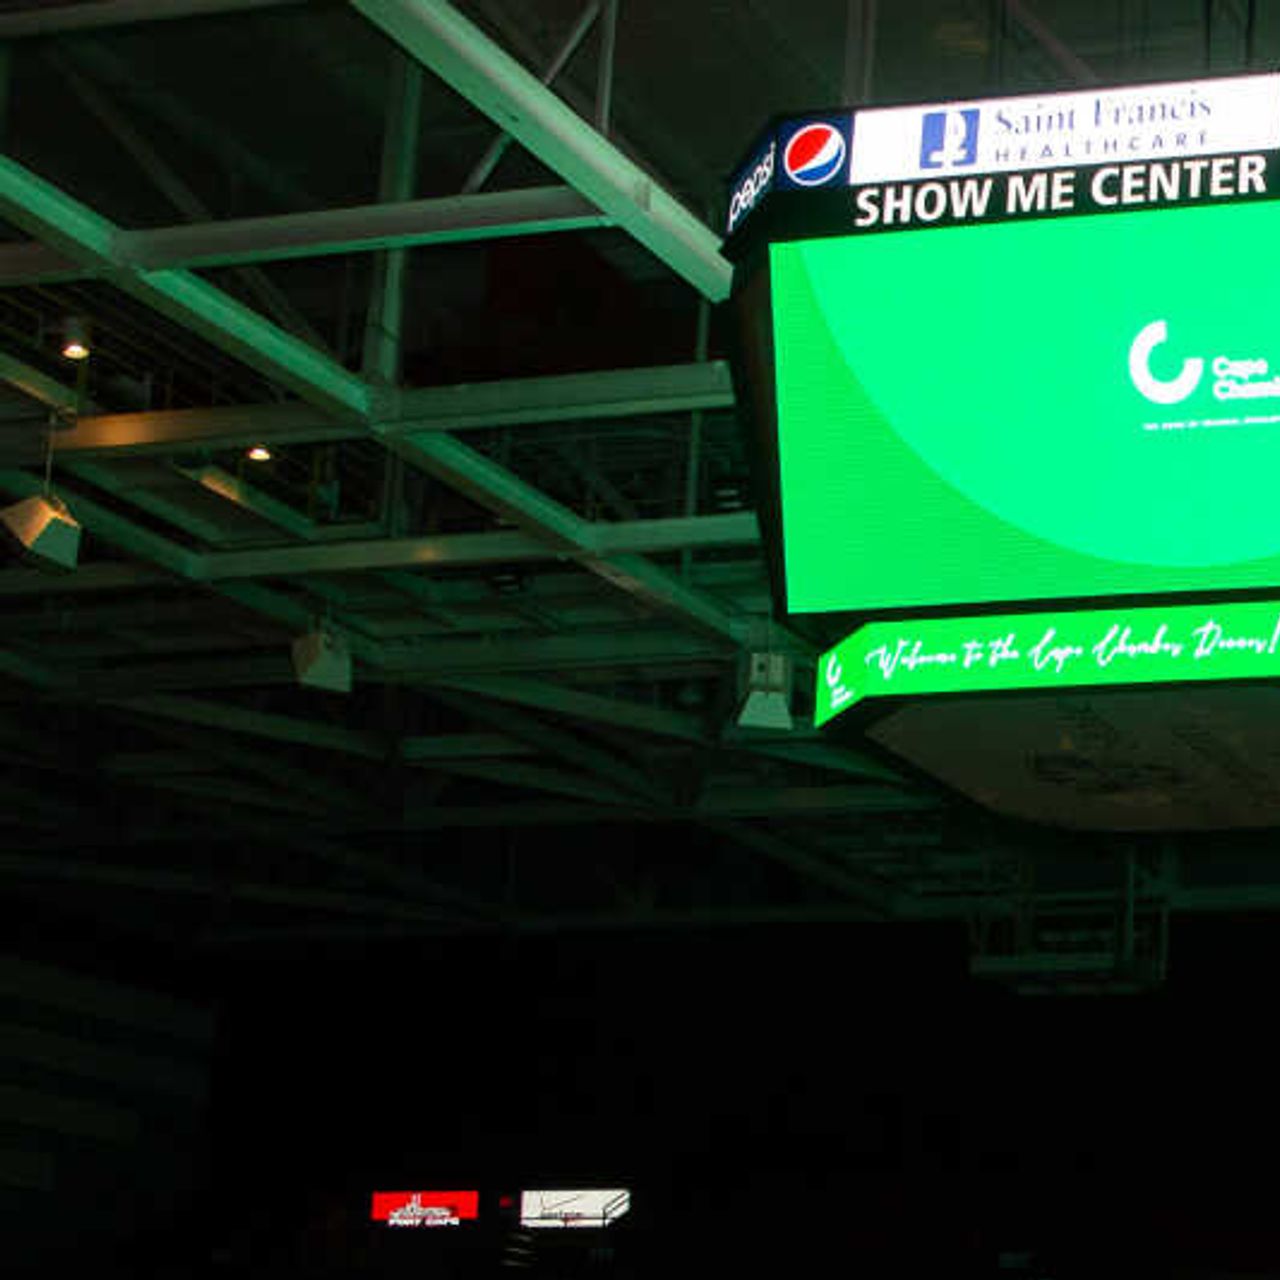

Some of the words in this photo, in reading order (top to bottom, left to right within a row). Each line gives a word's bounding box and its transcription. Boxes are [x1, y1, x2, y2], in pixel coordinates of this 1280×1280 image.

[996, 103, 1075, 134] Saint
[727, 141, 776, 233] pepsi
[854, 178, 993, 227] SHOW
[1006, 170, 1076, 213] ME
[1091, 155, 1267, 206] CENTER
